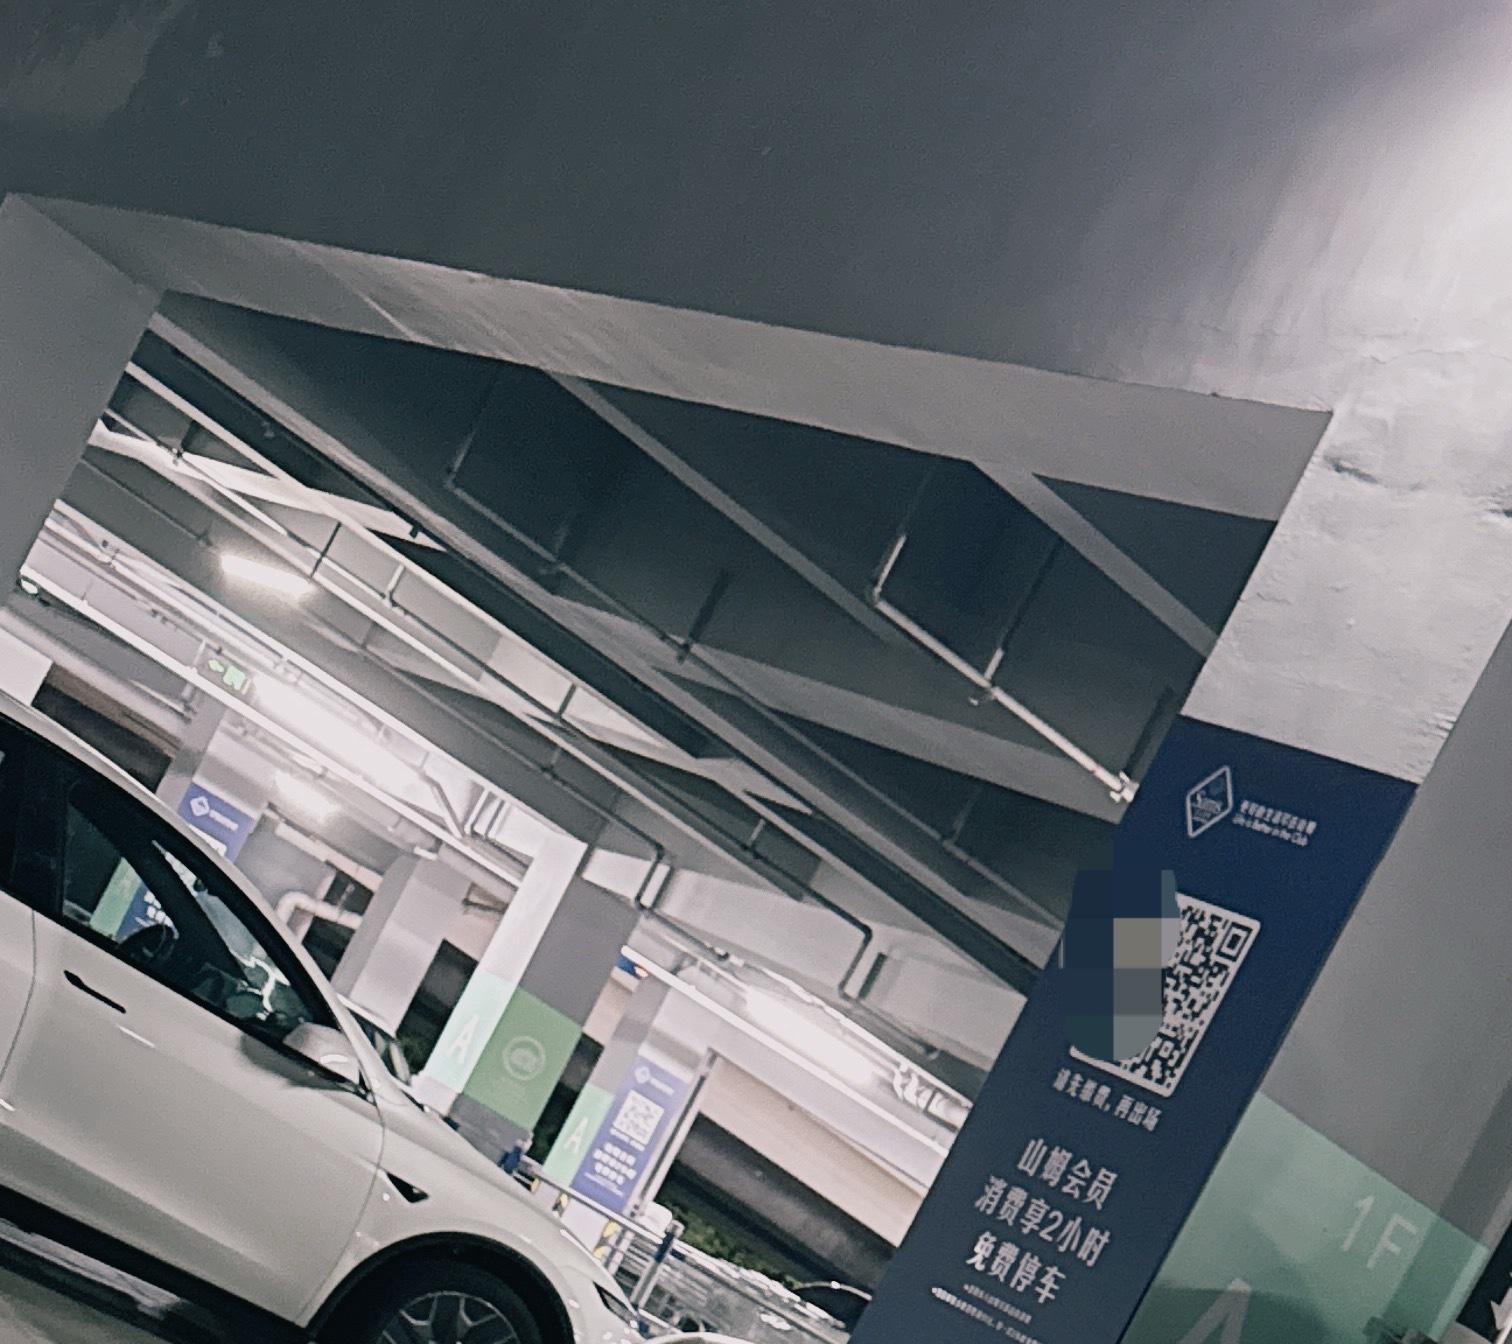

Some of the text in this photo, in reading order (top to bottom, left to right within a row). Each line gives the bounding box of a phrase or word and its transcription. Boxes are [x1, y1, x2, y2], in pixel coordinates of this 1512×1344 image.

[1017, 1138, 1118, 1210] 山姆会员
[974, 1174, 1111, 1268] 消费享2小时
[965, 1231, 1067, 1304] 免费停车
